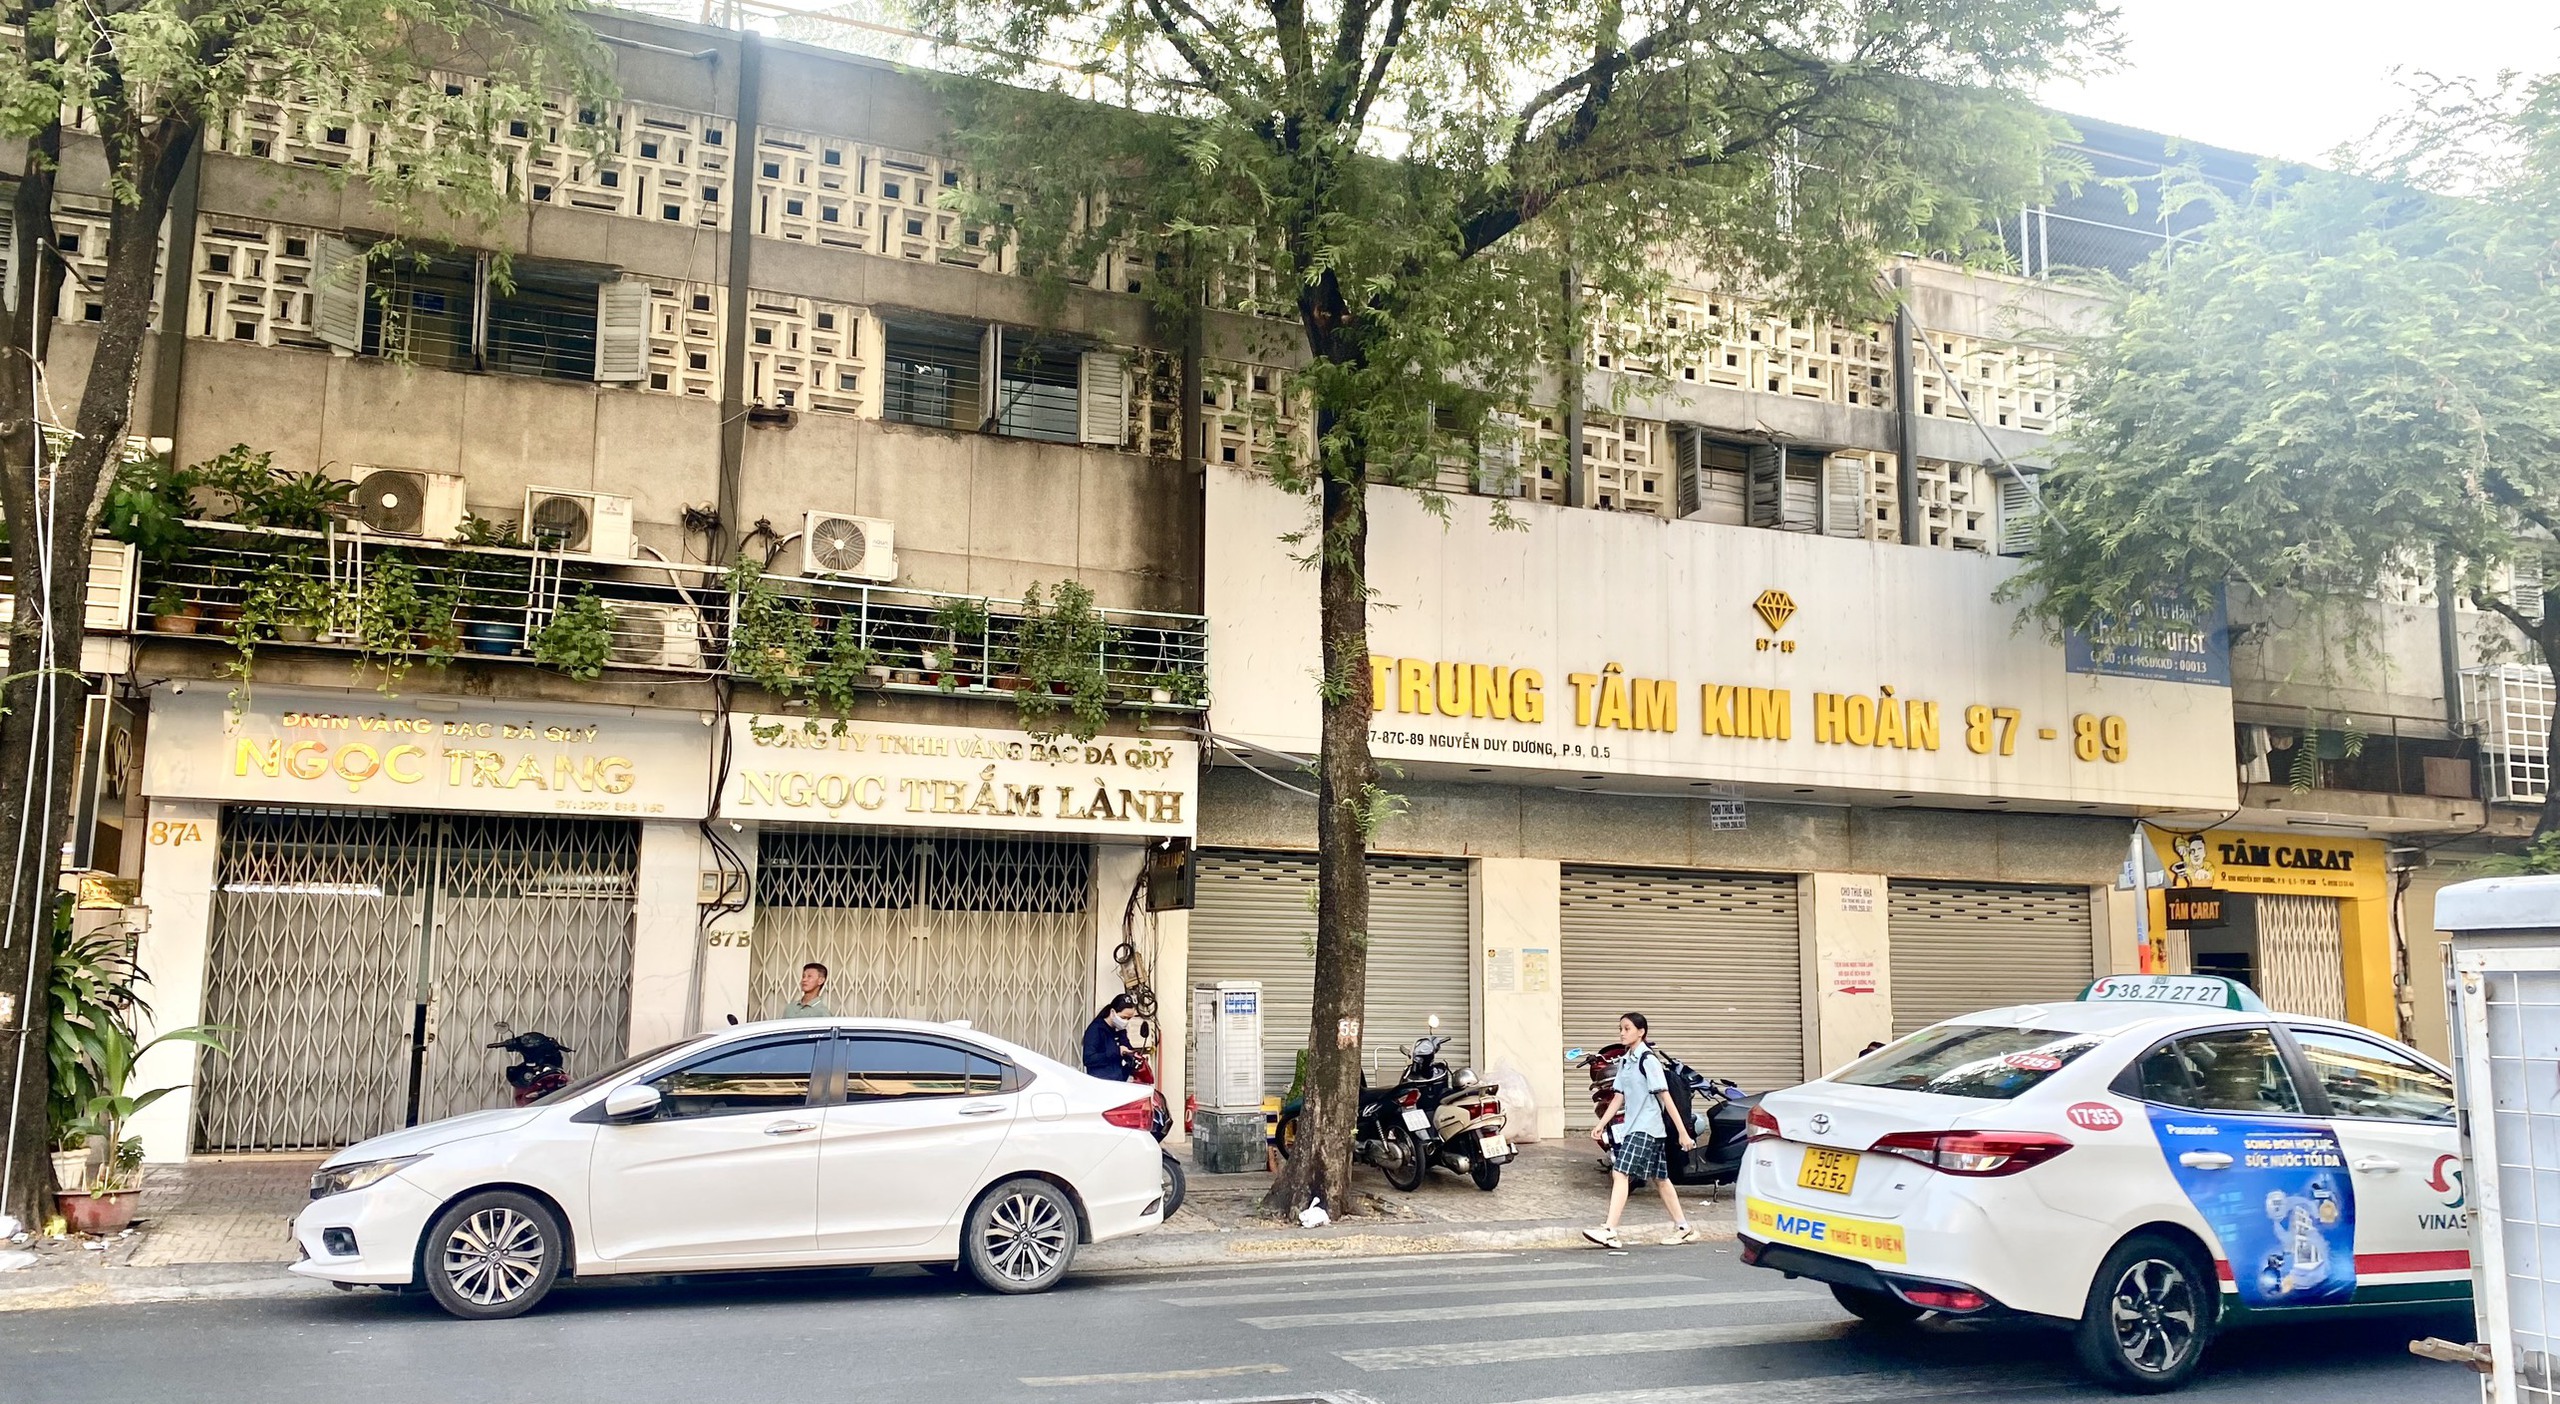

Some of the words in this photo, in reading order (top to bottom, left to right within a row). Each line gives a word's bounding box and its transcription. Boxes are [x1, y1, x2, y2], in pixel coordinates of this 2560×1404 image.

[2179, 659, 2207, 673] 00013
[1369, 654, 1544, 724] TRUNG
[1568, 661, 1678, 733] TÂM
[1701, 683, 1791, 741] KIM
[1813, 684, 1941, 751] HOÀN
[1964, 705, 2022, 756] 87
[2072, 713, 2129, 764] 89
[356, 711, 433, 735] VÀNG
[442, 720, 494, 741] BẠC
[543, 723, 599, 744] QUÝ
[837, 730, 871, 752] TY
[876, 733, 949, 757] TNHH
[955, 733, 1023, 761] VÀNG
[1029, 742, 1079, 767] BẠC
[1084, 742, 1118, 766] ĐÁ
[1124, 746, 1174, 770] QUÝ
[1366, 730, 1425, 746] 7-87C-89
[1428, 731, 1480, 751] NGUYỄN
[1512, 740, 1558, 758] DƯƠNG,
[233, 736, 426, 793] NGỌC
[442, 748, 636, 795] TRANG
[738, 768, 886, 819] NGỌC
[899, 763, 1045, 818] THẮM
[1056, 776, 1185, 824] LÀNH
[149, 820, 202, 847] 87A
[2218, 838, 2271, 867] TÂM
[2275, 846, 2355, 871] CARAT
[2168, 898, 2189, 920] TÂM
[2190, 901, 2220, 920] CARAT
[709, 929, 751, 948] 87B
[2118, 983, 2169, 999] 38.27
[2169, 985, 2196, 1001] 27
[2197, 986, 2223, 1002] 27
[2008, 1054, 2058, 1070] 17355
[2070, 1107, 2121, 1126] 17355
[2165, 1123, 2220, 1136] Panasonic
[1817, 1151, 1841, 1170] 50E
[1805, 1169, 1847, 1191] 123.52
[1776, 1213, 1827, 1241] MPE
[1830, 1224, 1858, 1247] THIẾT
[1861, 1235, 1873, 1250] BỊ
[1875, 1234, 1902, 1254] ĐIỆN
